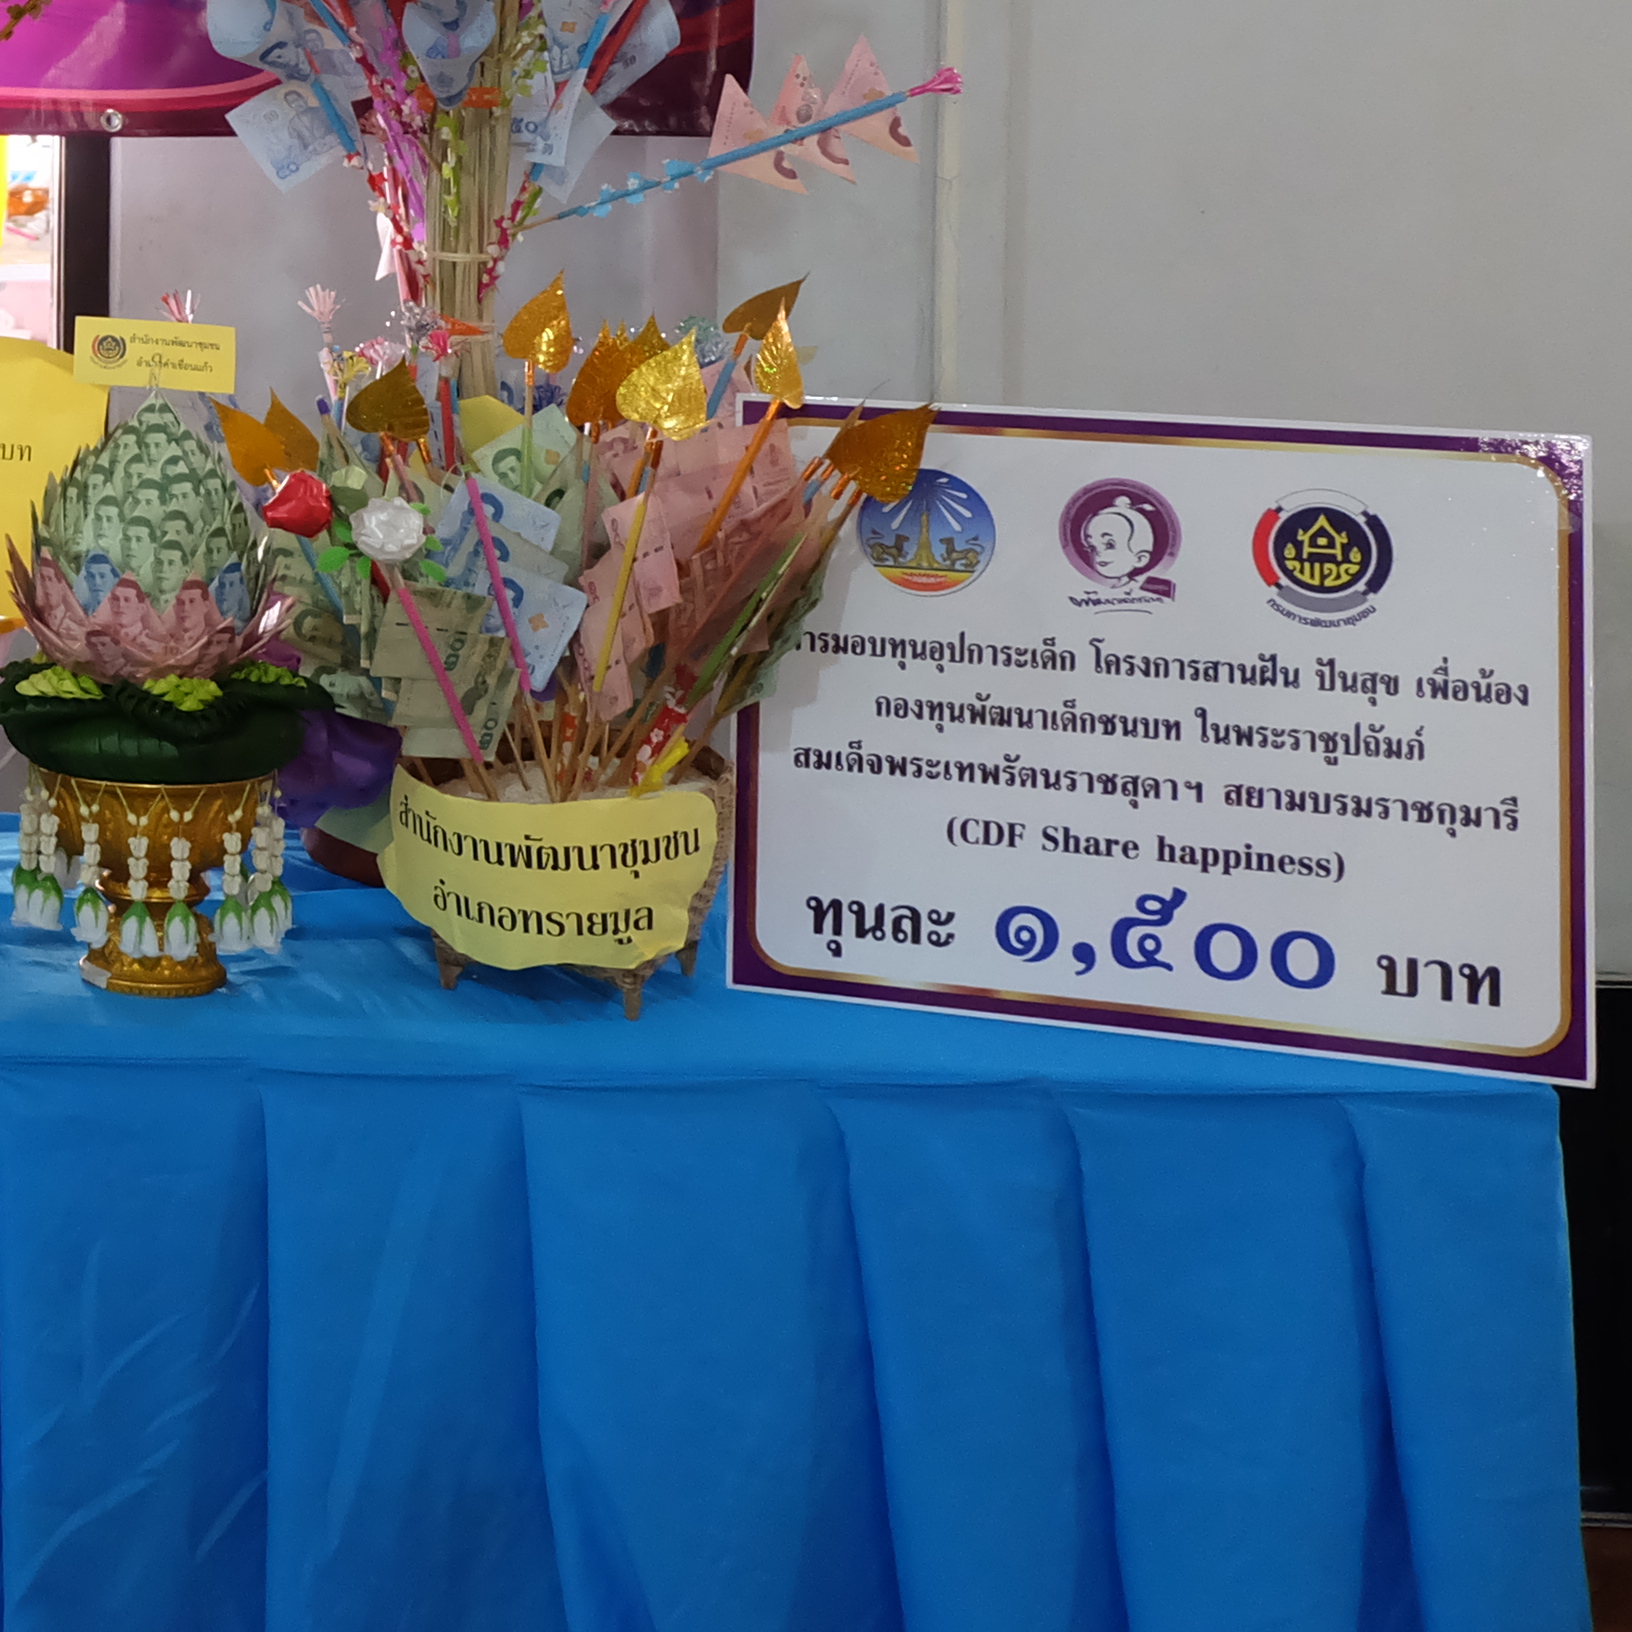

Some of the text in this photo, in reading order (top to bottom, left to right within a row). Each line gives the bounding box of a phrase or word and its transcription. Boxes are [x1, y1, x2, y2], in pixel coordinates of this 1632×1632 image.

[794, 629, 1531, 708] ารมอบทุนอุปการะเด็ก โครงการสานฝัน ปันสุข เพื่อน้อง
[874, 691, 1427, 767] กองทุนพัฒนาเด็กชนบท ในพระราชูปถัมภ์
[792, 739, 1521, 838] สมเด็จพระเทพรัตนราชสุดาฯ สยามบรมราชกุมารี
[398, 794, 702, 879] สำนักงานพัฒนาชุมชน
[945, 816, 1347, 885] (CDF Share happiness)
[432, 878, 656, 945] อำเภอทรายมูล
[803, 887, 1503, 1008] ทุนละ ๑,๕๐๐ บาท
